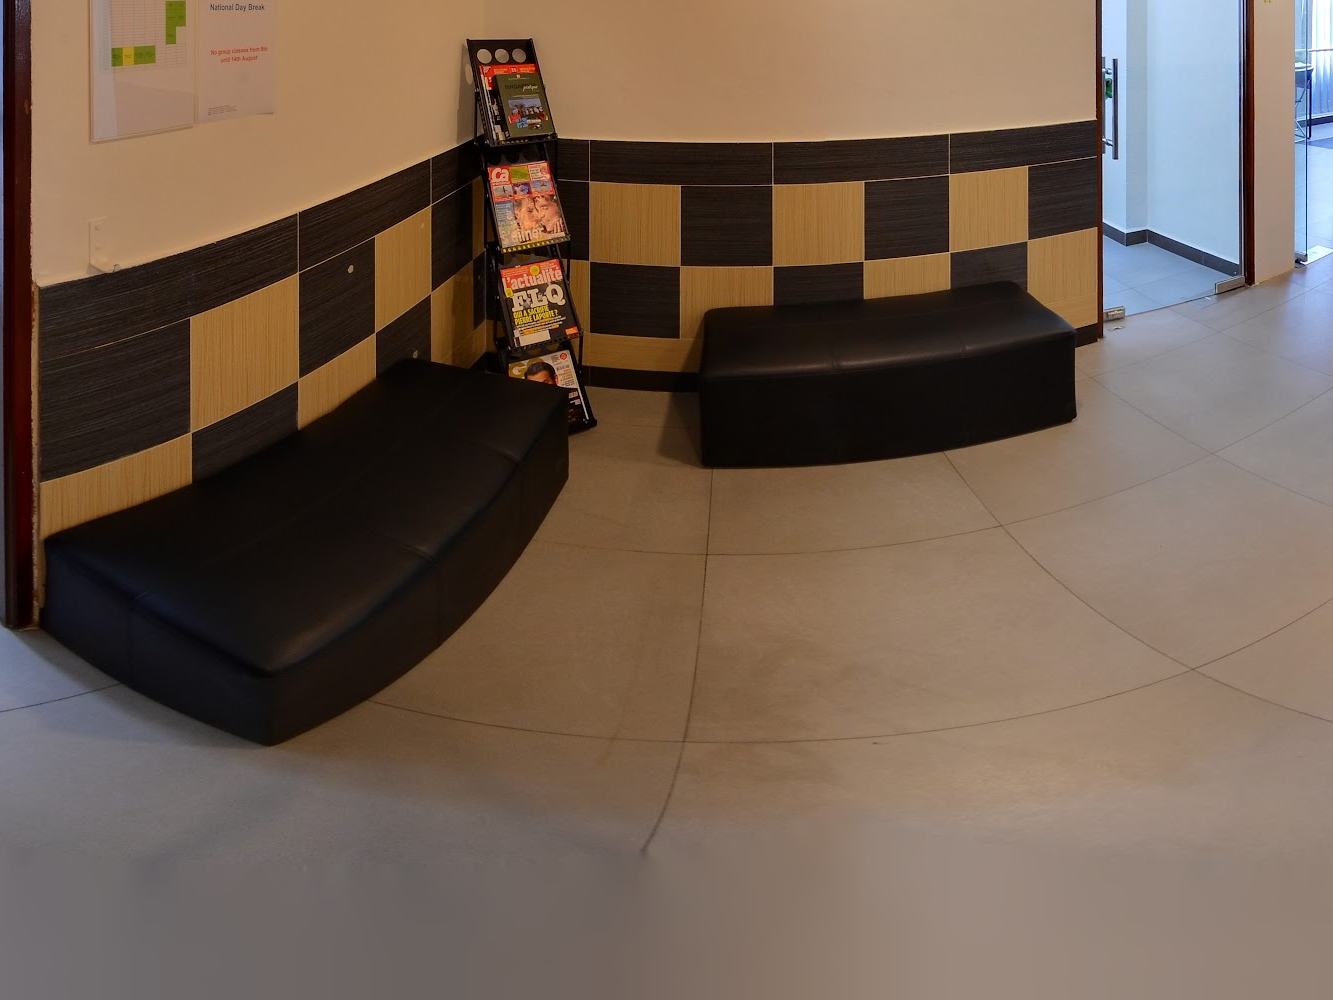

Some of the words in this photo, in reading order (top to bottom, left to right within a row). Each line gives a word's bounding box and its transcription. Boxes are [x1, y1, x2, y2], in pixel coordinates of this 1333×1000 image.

[210, 3, 234, 11] National
[235, 3, 247, 12] Day
[248, 3, 265, 11] Break
[218, 49, 231, 57] group
[512, 284, 566, 312] FLQ
